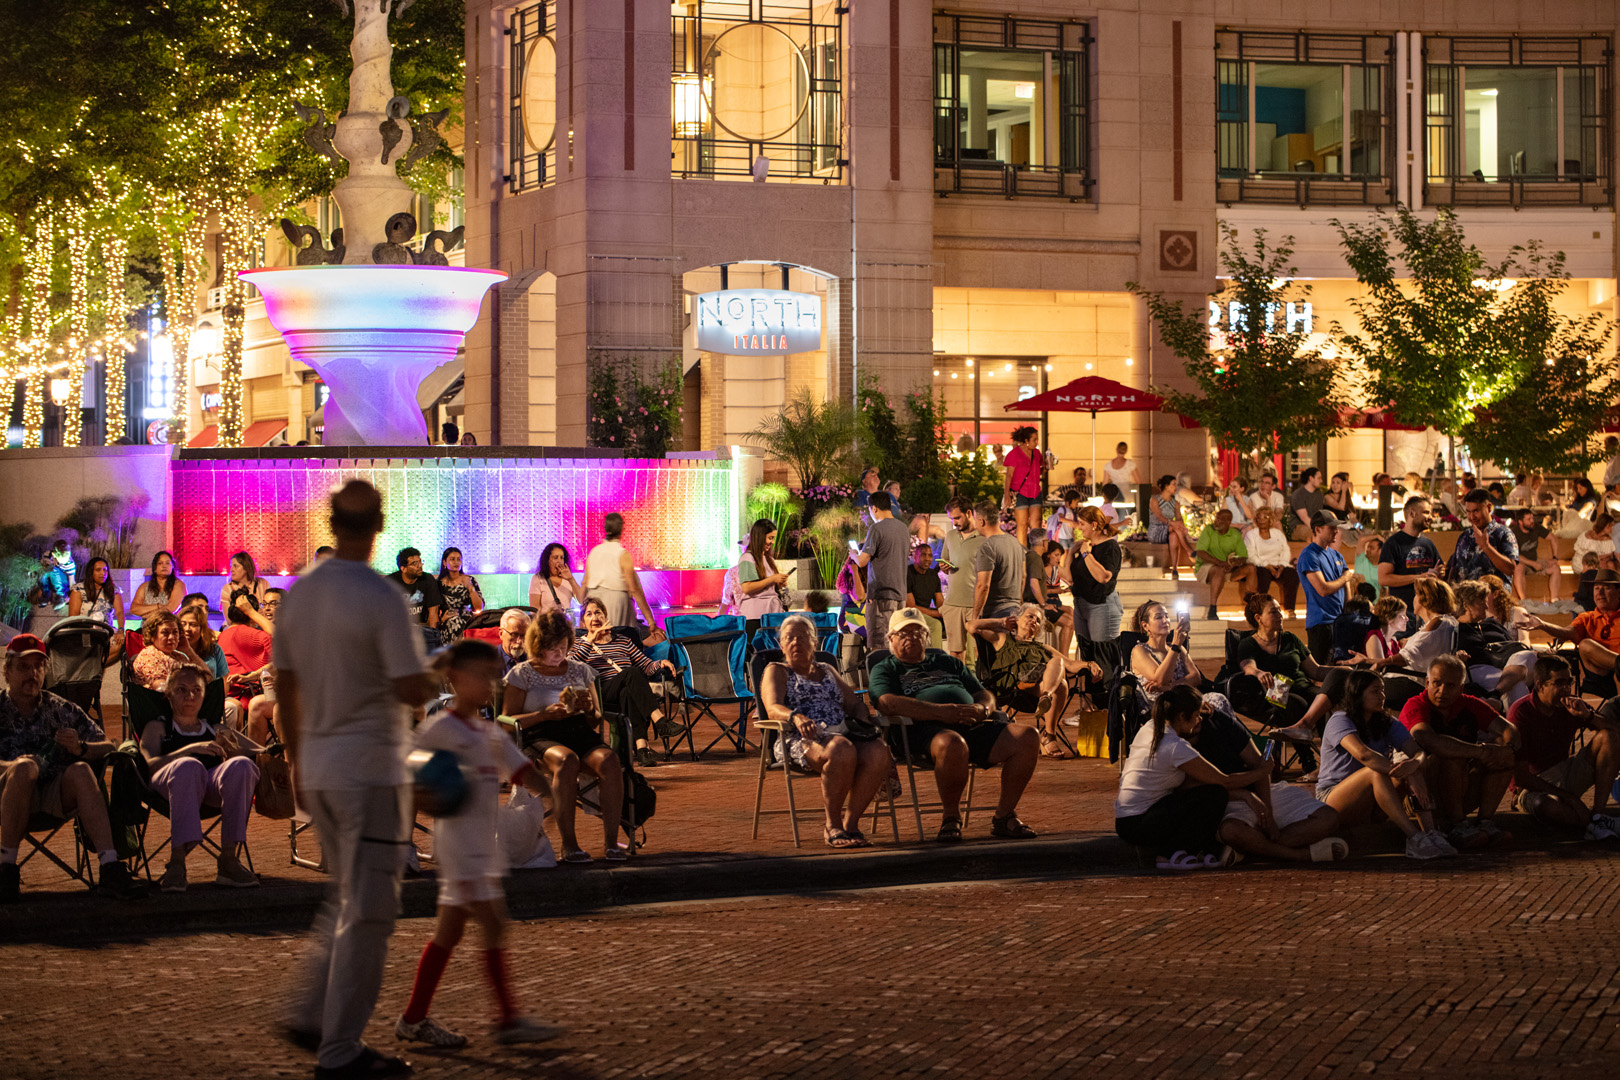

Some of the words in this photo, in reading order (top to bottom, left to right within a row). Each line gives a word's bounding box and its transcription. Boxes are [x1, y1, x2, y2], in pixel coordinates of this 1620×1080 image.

[699, 296, 817, 328] NORTH
[733, 334, 789, 350] ITALIA
[1056, 394, 1136, 403] NORTH
[407, 605, 424, 616] ODAY
